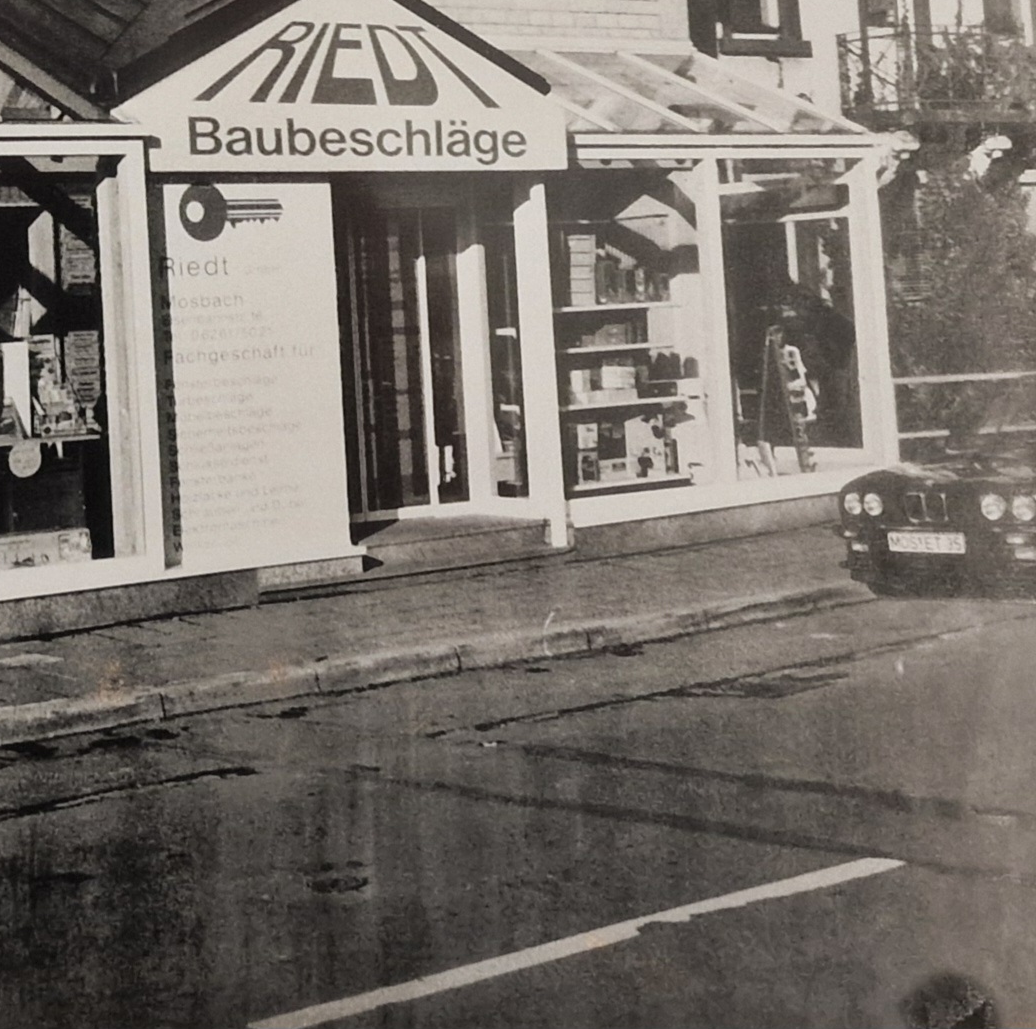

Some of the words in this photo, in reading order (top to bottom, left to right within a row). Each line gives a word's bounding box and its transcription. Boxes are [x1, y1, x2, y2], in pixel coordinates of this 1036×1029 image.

[193, 20, 502, 109] RIEDT
[187, 116, 528, 166] Baubeschläge
[159, 255, 229, 277] Riedt
[161, 293, 245, 311] Mosbach
